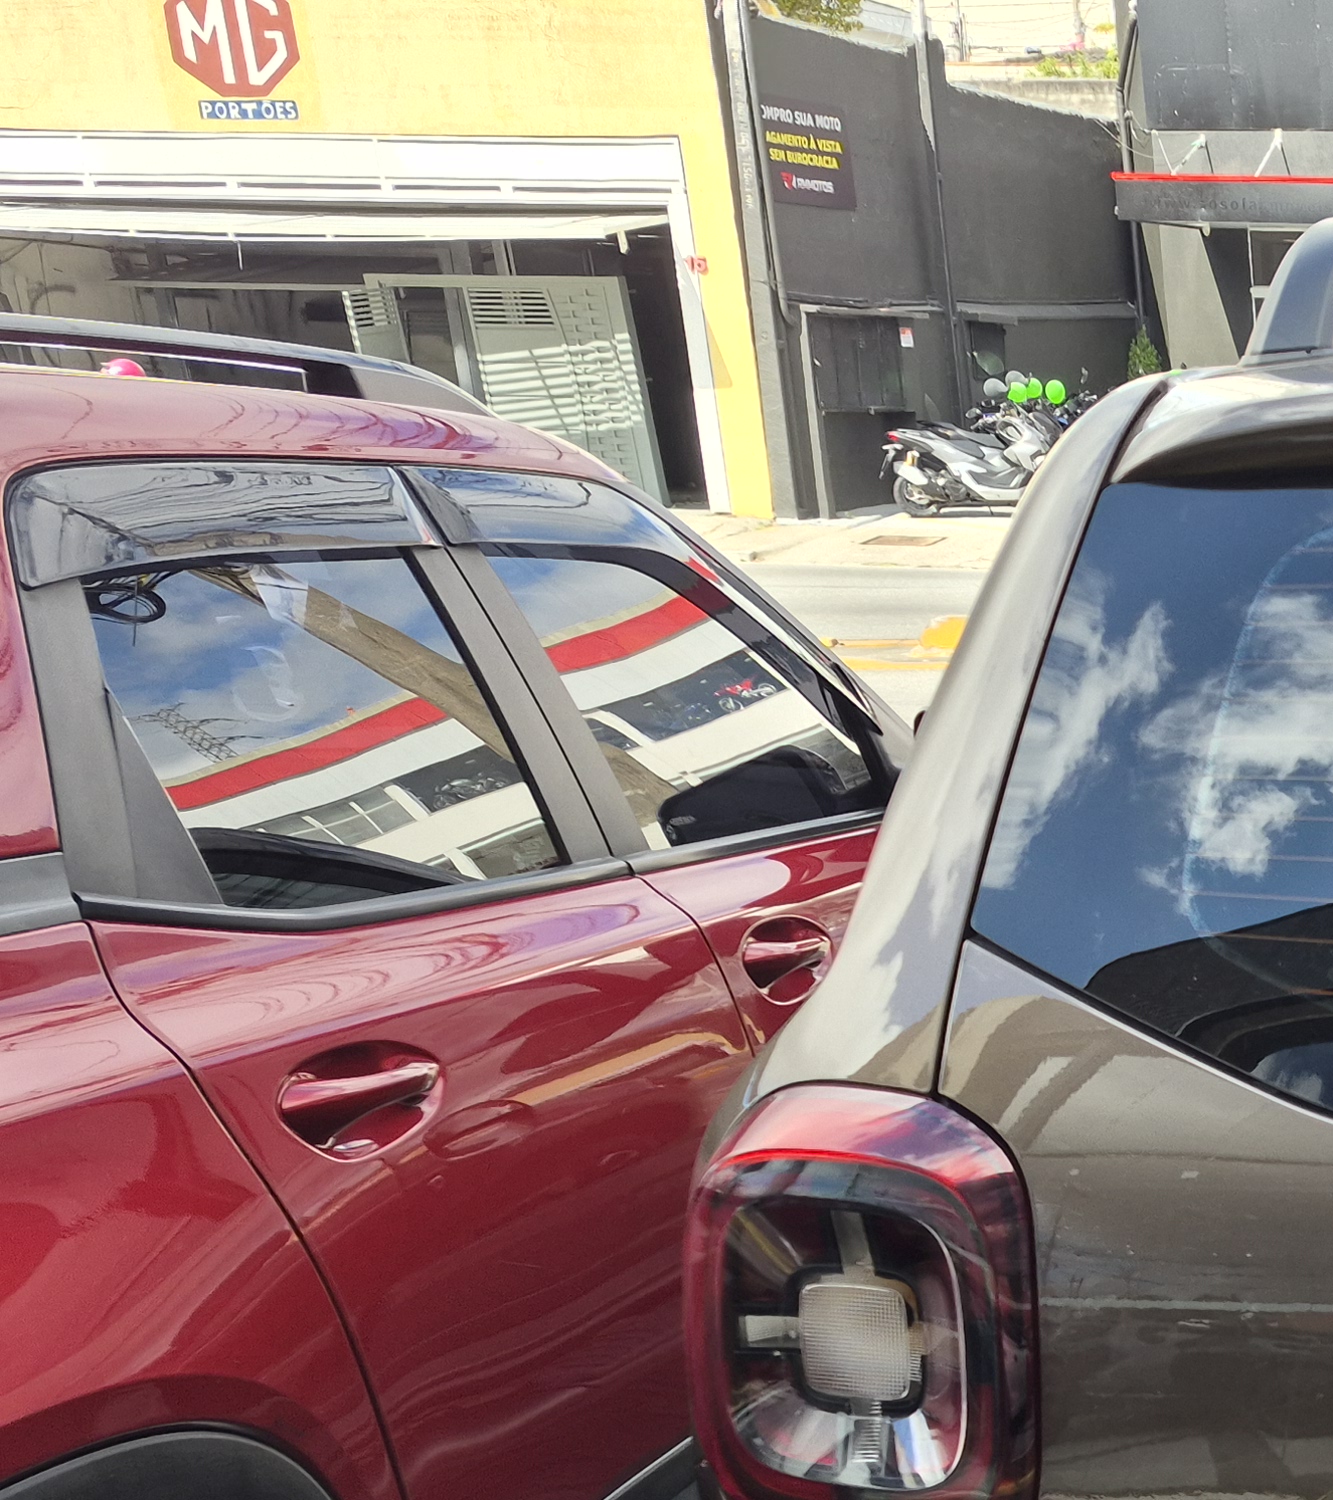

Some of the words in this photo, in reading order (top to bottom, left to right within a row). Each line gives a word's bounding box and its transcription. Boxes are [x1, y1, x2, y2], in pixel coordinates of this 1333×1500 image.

[176, 0, 288, 86] MG
[200, 101, 297, 119] PORTÕES
[760, 104, 793, 124] OMPRO
[794, 111, 814, 127] SUA
[815, 114, 841, 132] MOTO
[765, 131, 808, 149] AGAMENTO
[817, 138, 843, 154] VISTA
[769, 148, 785, 162] SEM
[786, 150, 839, 170] BUROCRACIA
